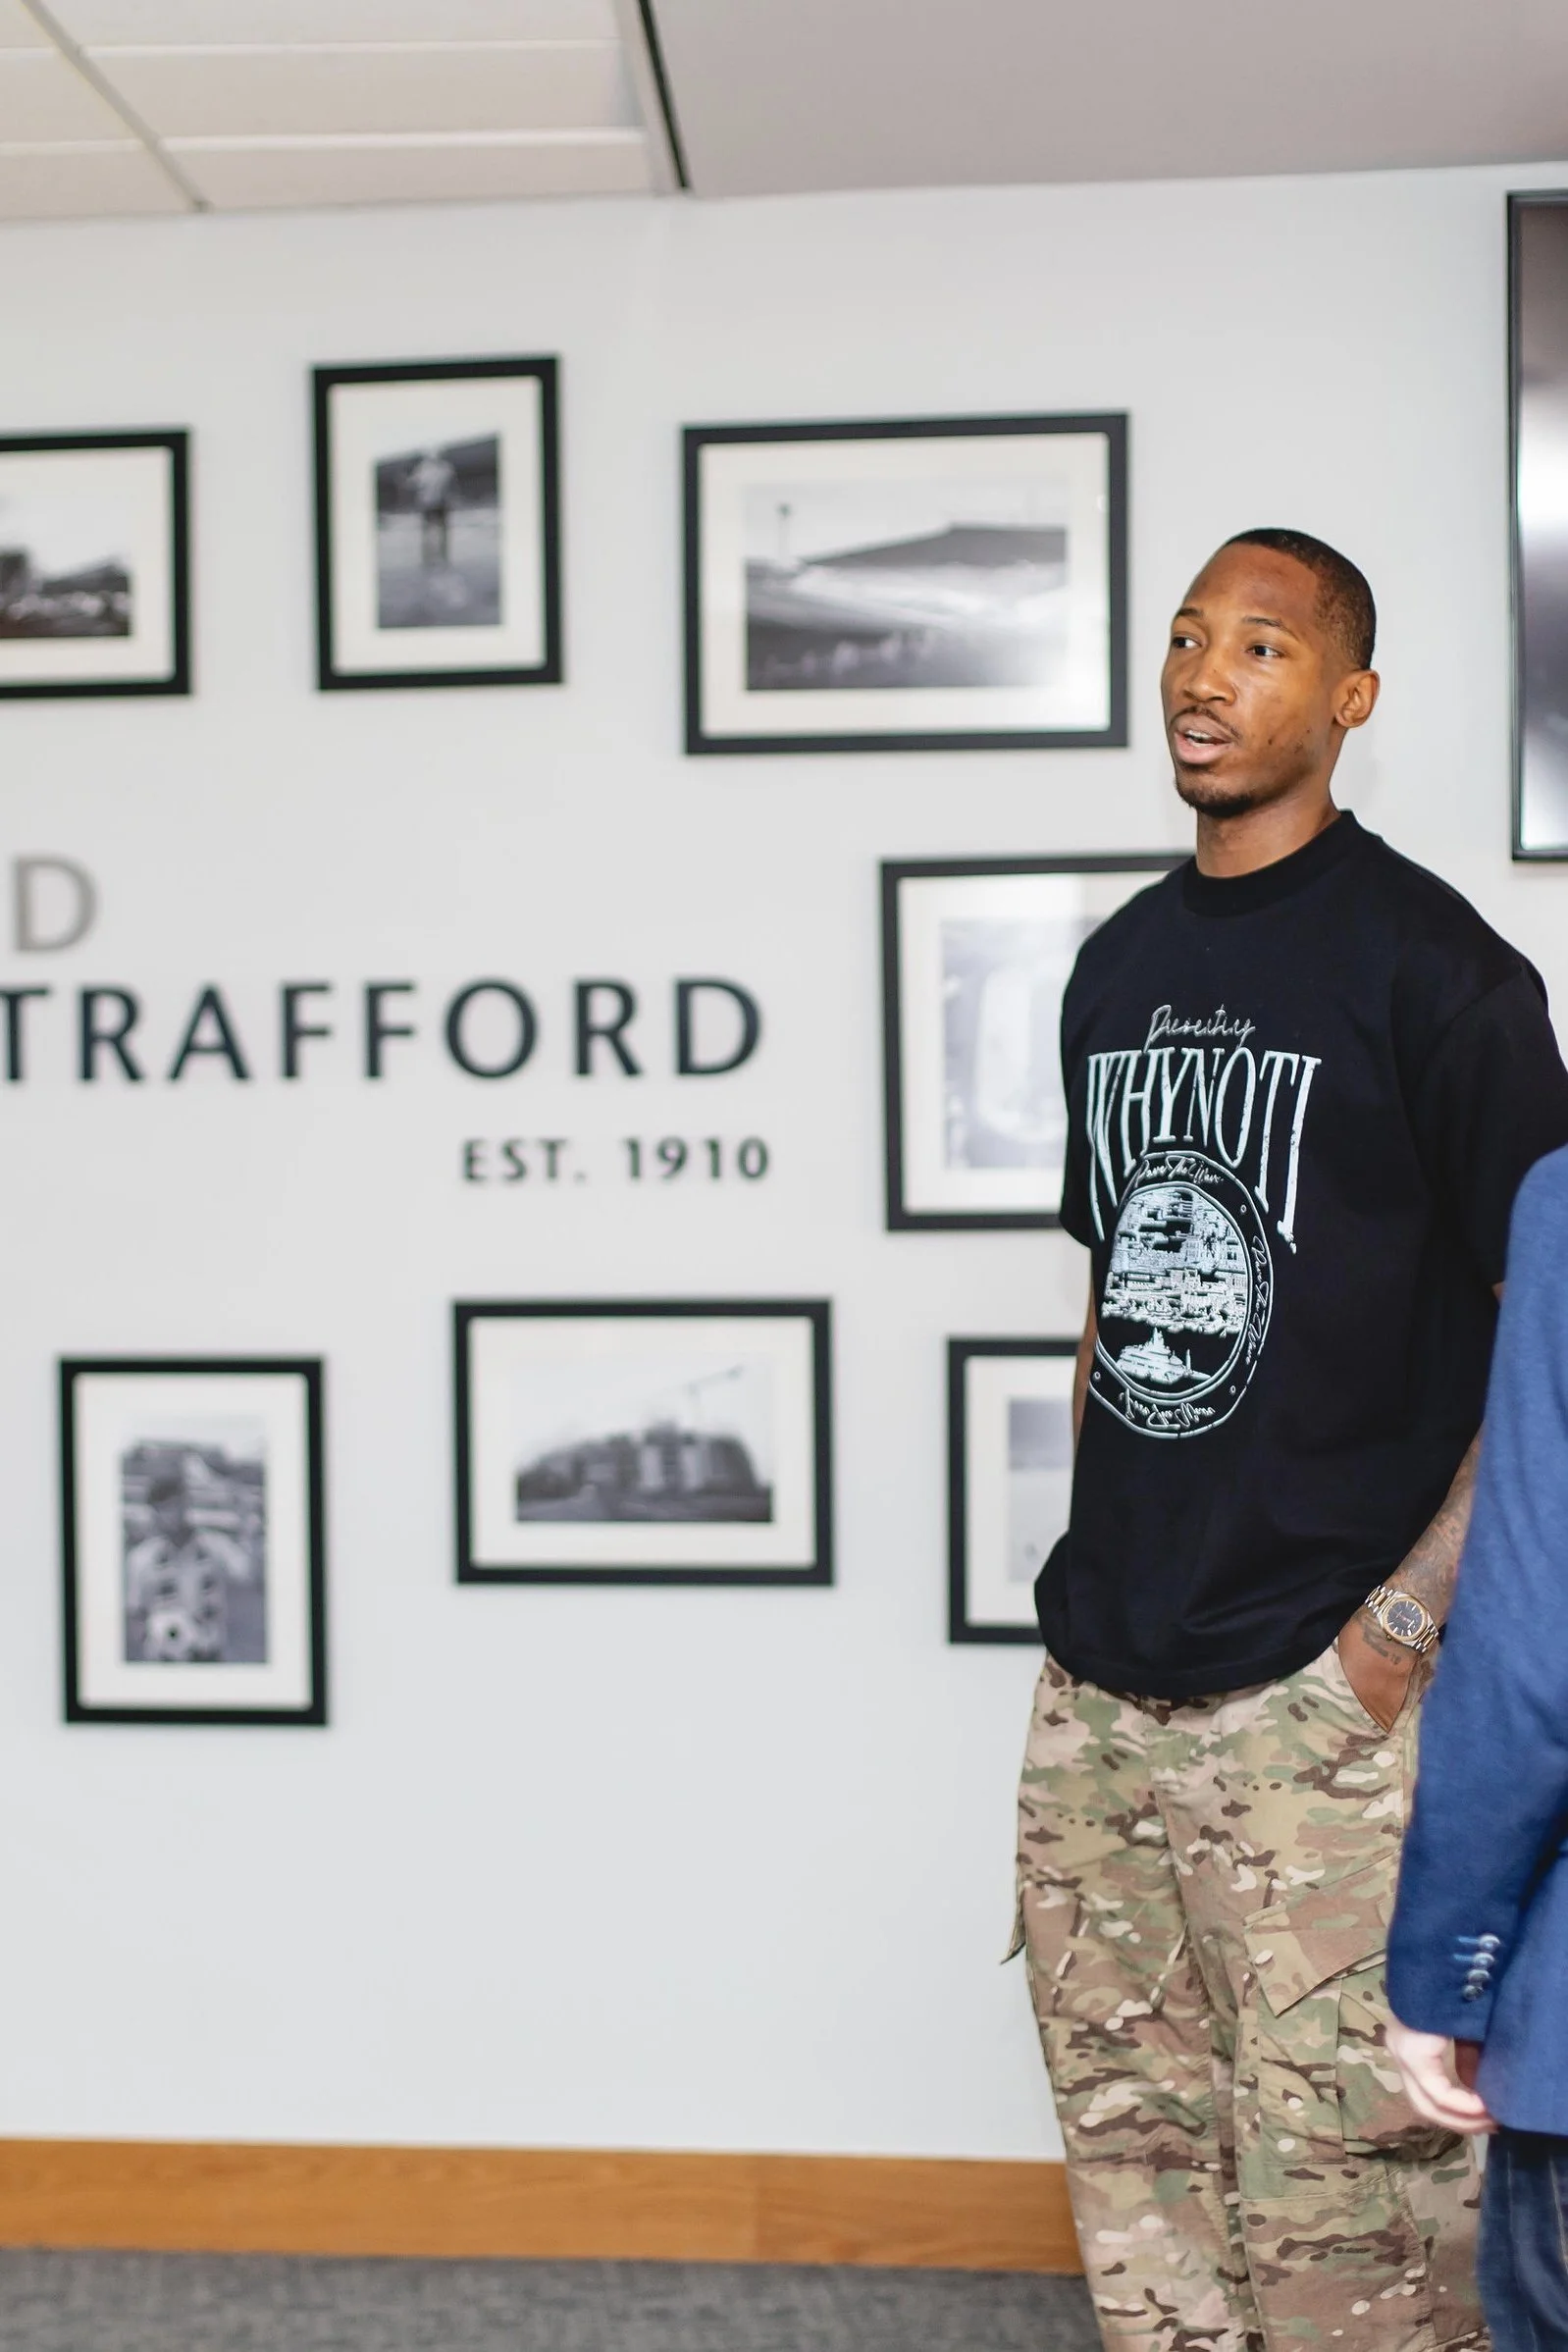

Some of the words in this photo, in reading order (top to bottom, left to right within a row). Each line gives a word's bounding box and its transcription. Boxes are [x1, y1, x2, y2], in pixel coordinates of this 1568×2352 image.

[0, 975, 764, 1082] TRAFFORD
[461, 1137, 589, 1184] EST.
[622, 1135, 770, 1182] 1910
